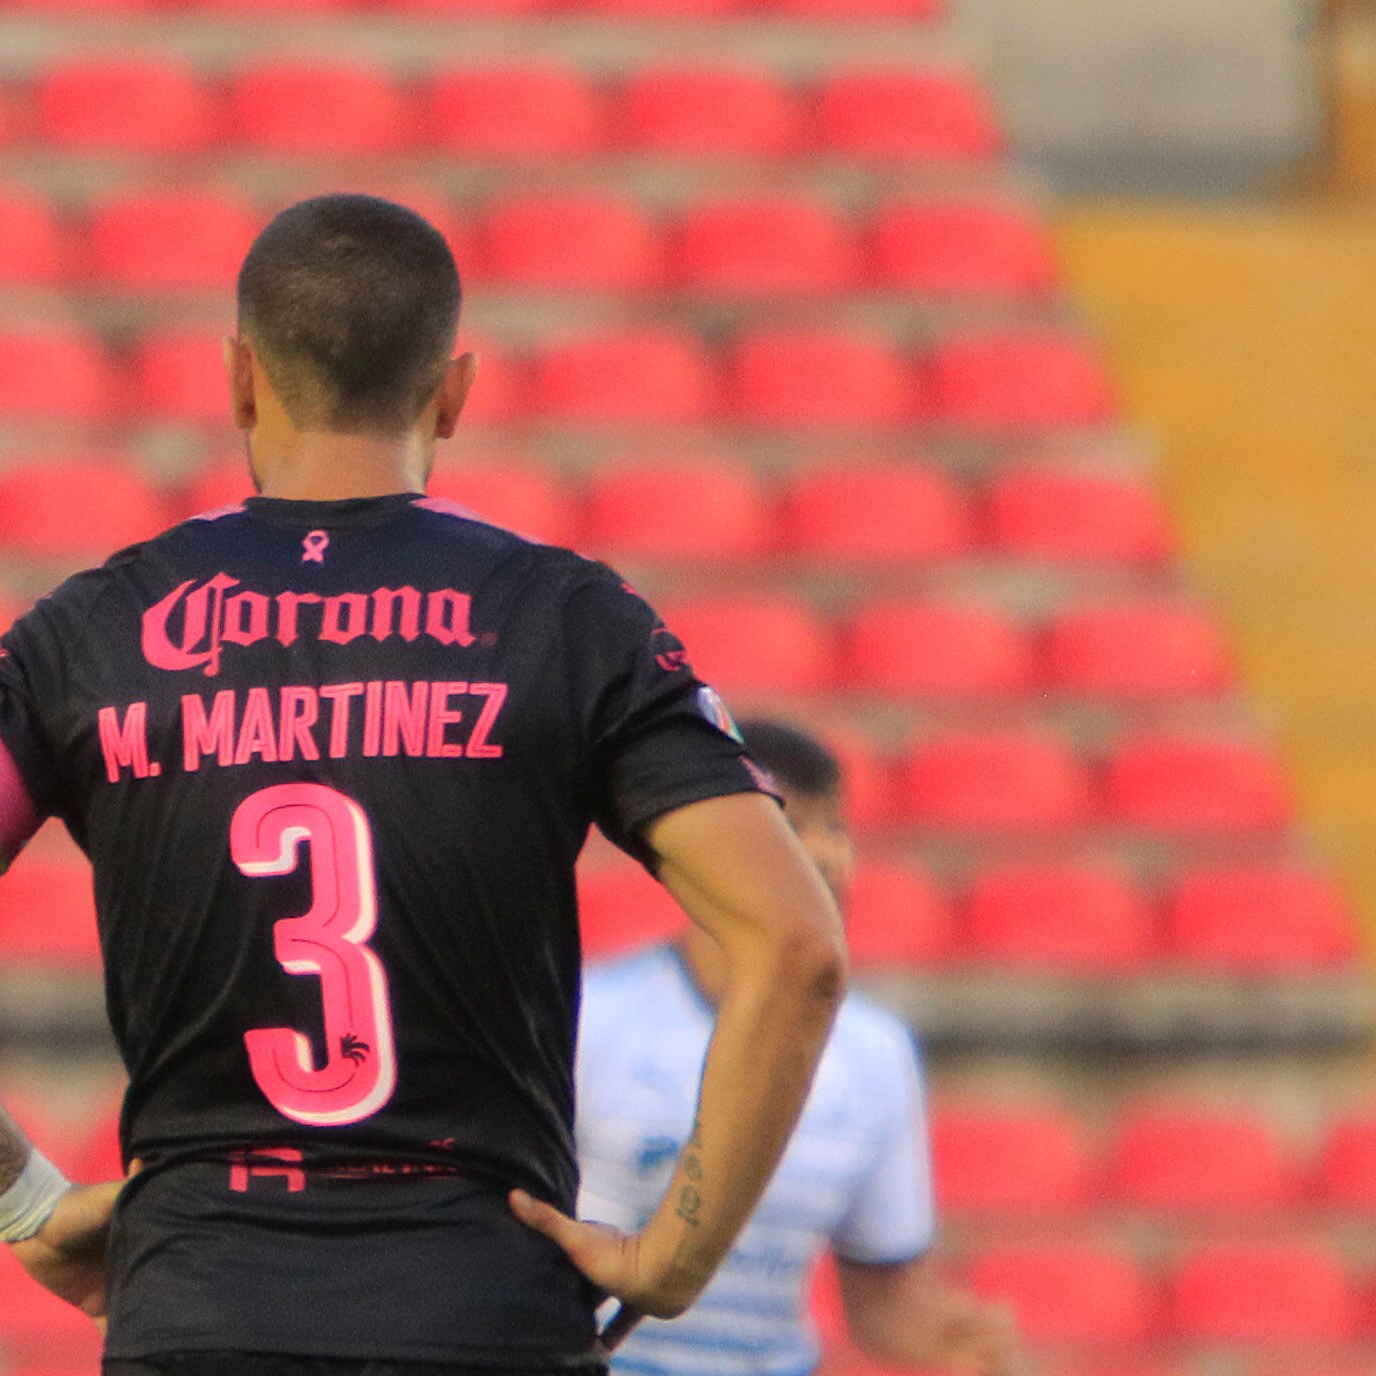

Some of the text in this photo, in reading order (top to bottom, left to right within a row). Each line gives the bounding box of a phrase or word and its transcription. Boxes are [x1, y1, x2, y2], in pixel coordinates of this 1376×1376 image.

[141, 572, 476, 677] Corona
[98, 681, 508, 784] M. MARTINEZ
[229, 783, 396, 1126] 3
